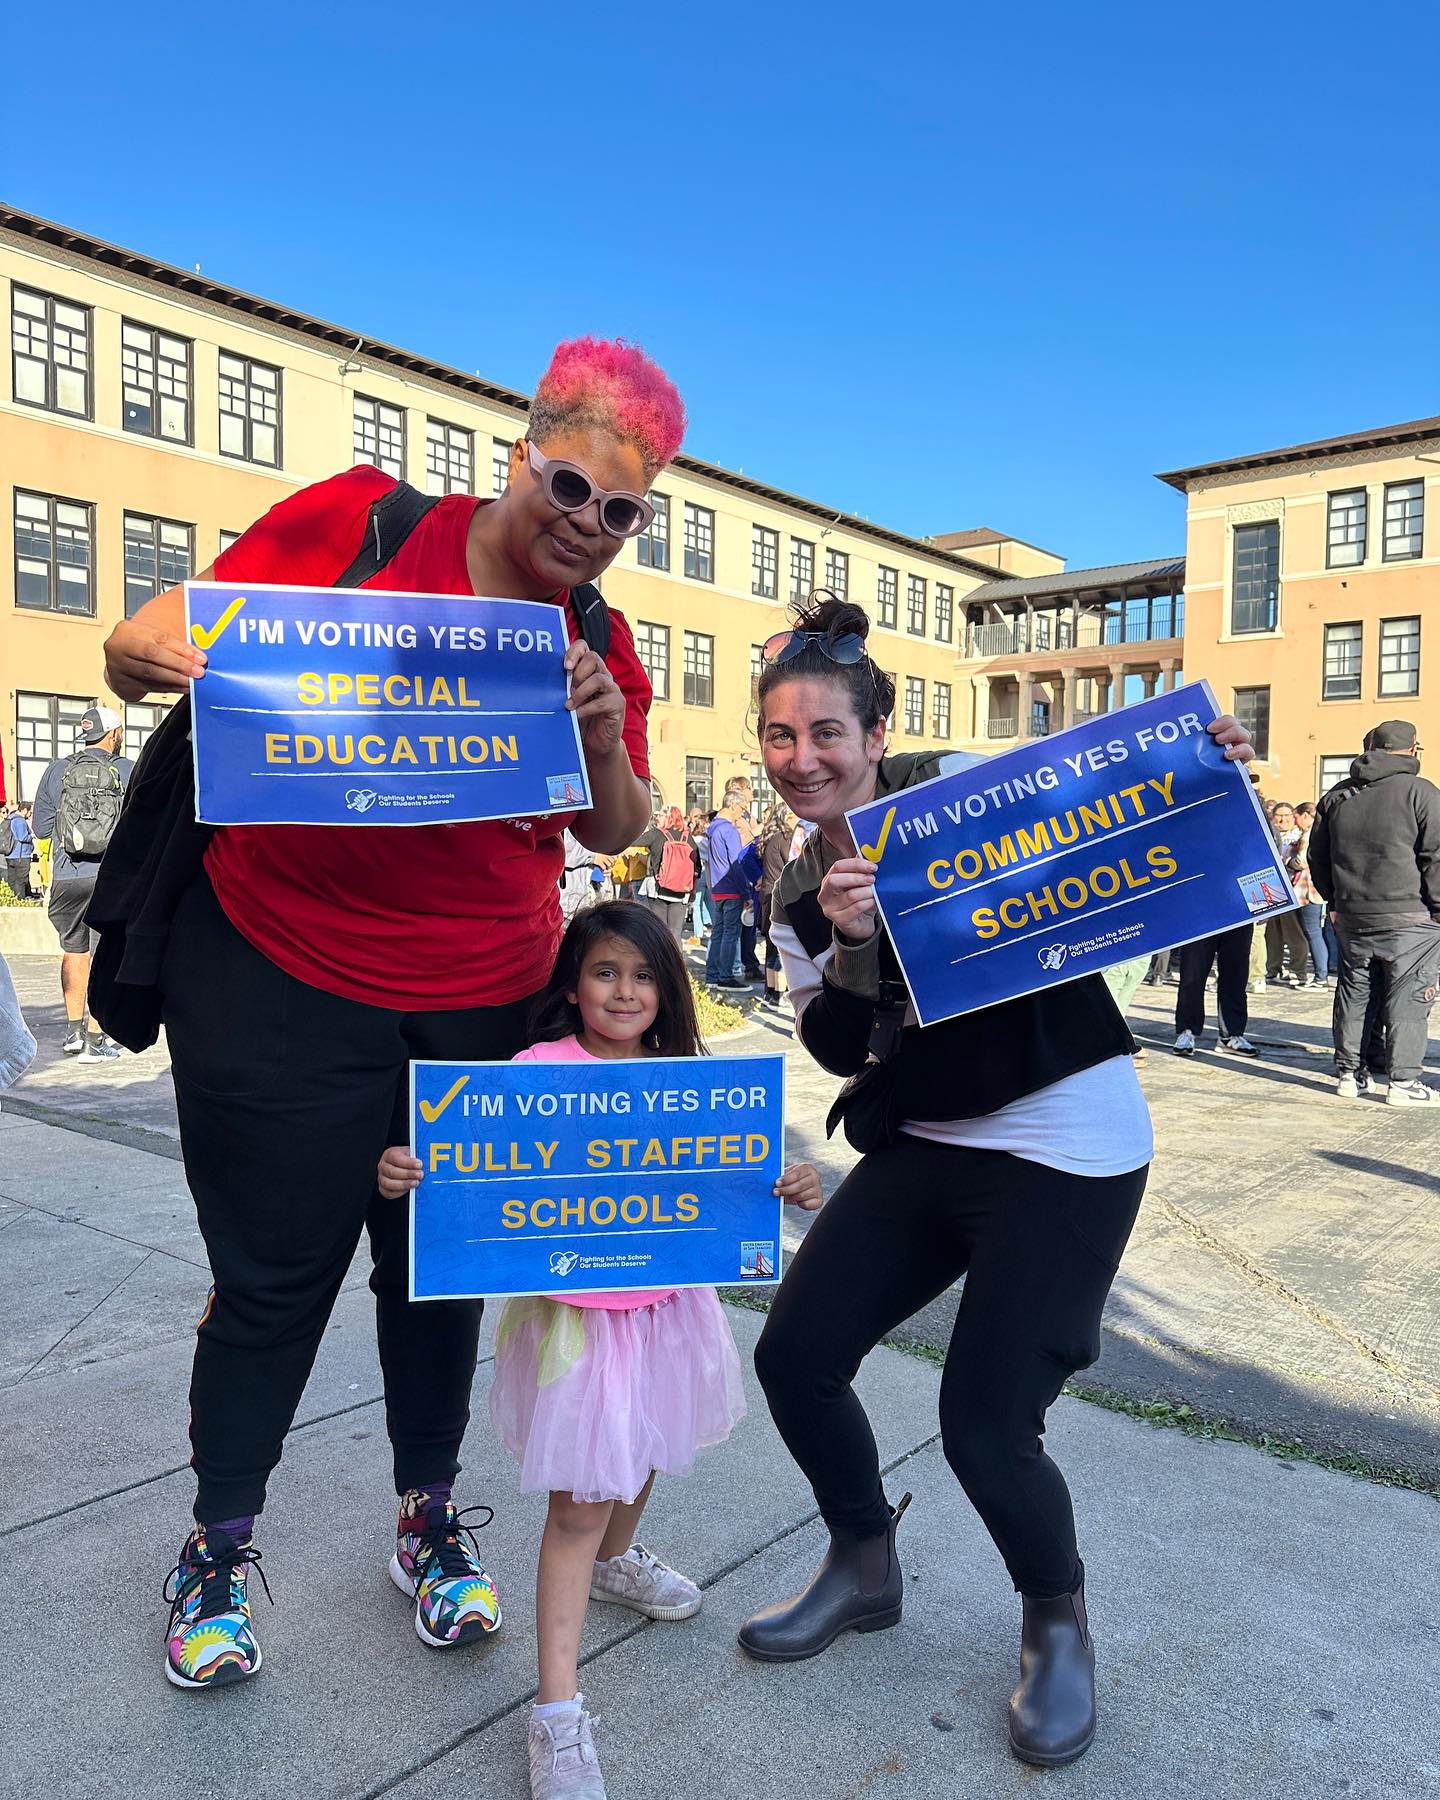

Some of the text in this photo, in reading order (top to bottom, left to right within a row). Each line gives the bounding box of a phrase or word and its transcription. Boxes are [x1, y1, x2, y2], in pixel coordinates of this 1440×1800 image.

[239, 618, 553, 652] I'M VOTING YES FOR
[297, 672, 480, 707] SPECIAL
[266, 732, 519, 765] EDUCATION
[896, 712, 1203, 845] I'M VOTING YES FOR
[926, 771, 1174, 890] COMMUNITY
[972, 845, 1178, 940] SCHOOLS
[1068, 940, 1095, 952] Fighting
[1118, 922, 1144, 935] Schools
[1084, 940, 1112, 953] Students
[1114, 931, 1140, 943] Deserve
[462, 1086, 766, 1116] I'M VOTING YES FOR
[429, 1134, 770, 1173] FULLY STAFFED
[501, 1193, 699, 1229] SCHOOLS
